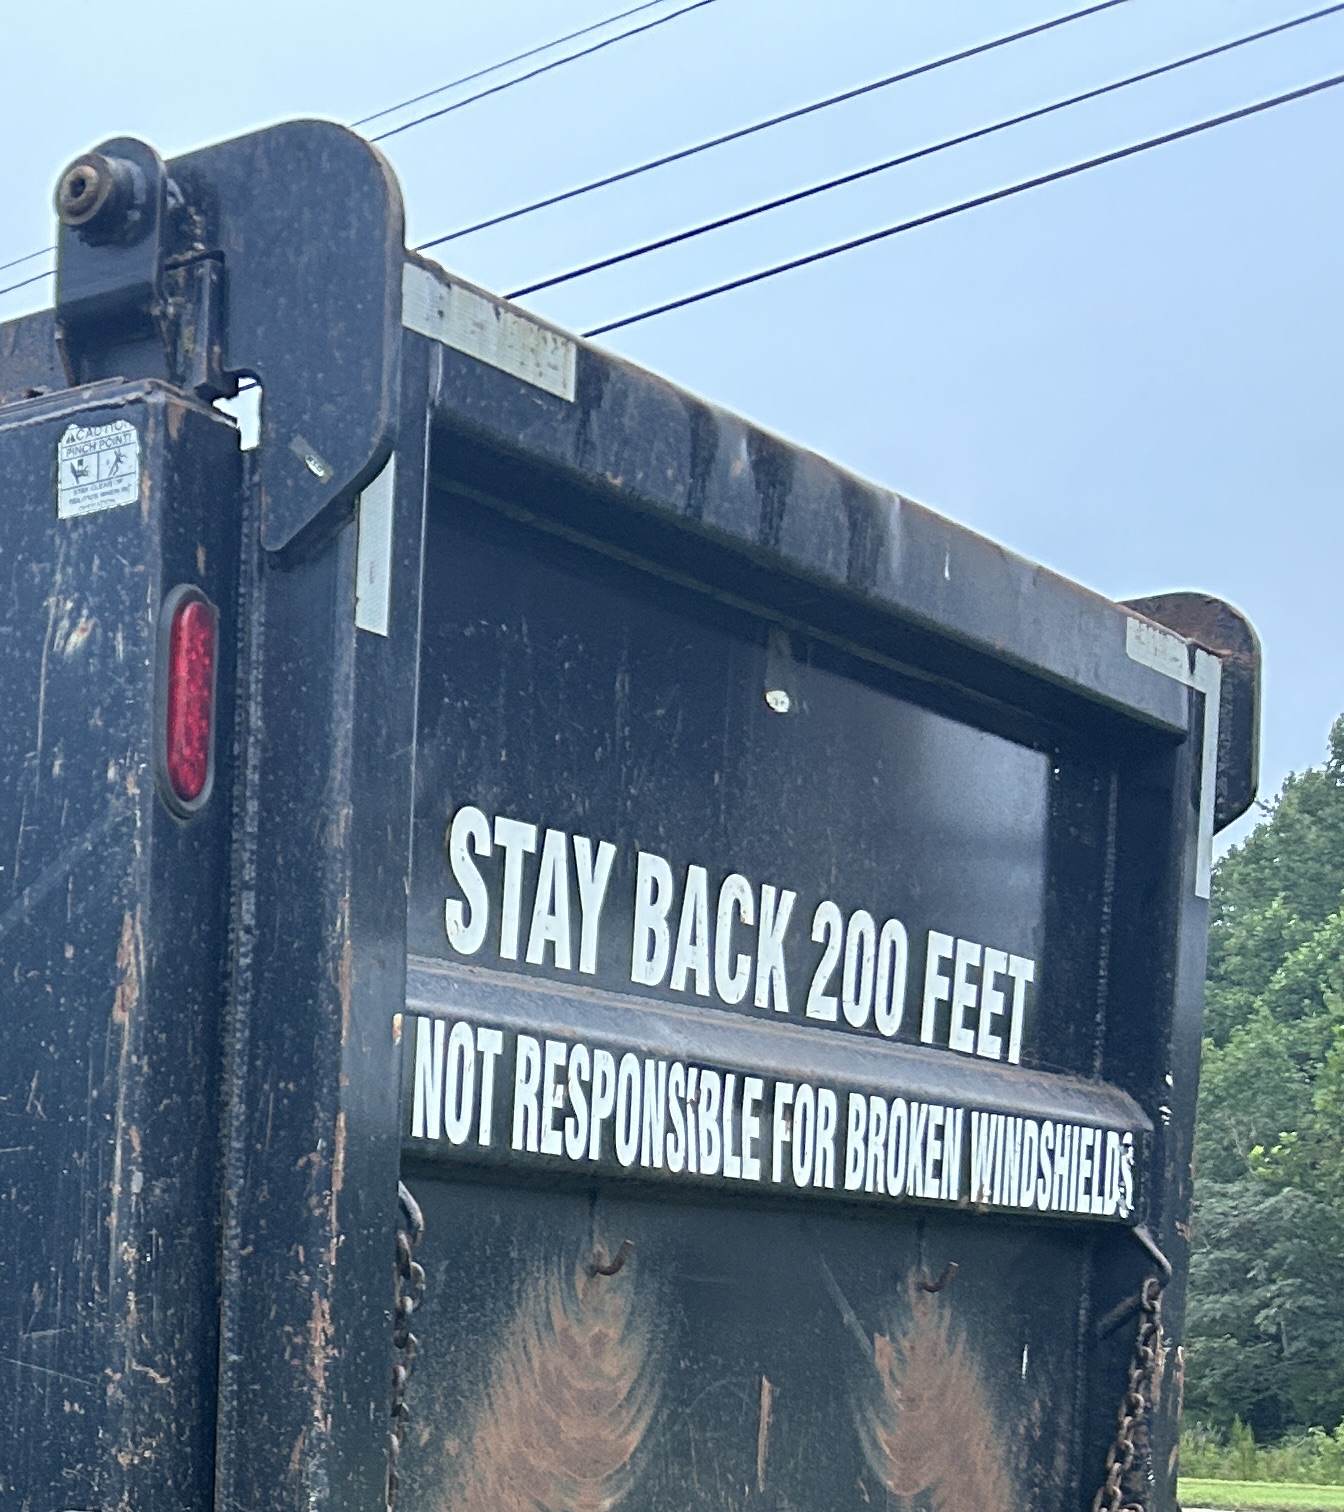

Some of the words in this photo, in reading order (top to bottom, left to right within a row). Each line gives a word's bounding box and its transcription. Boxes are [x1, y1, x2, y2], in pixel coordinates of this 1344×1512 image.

[65, 444, 97, 458] PINCH
[445, 805, 616, 975] STAY
[631, 850, 798, 1014] BACK
[805, 900, 909, 1037] 200
[919, 929, 1035, 1066] FEET
[411, 1016, 504, 1146] NOT
[511, 1033, 765, 1182] RESPONSIBLE
[771, 1080, 839, 1190] FOR
[843, 1092, 964, 1202] BROKEN
[969, 1109, 1136, 1219] WINDSHIELDS
